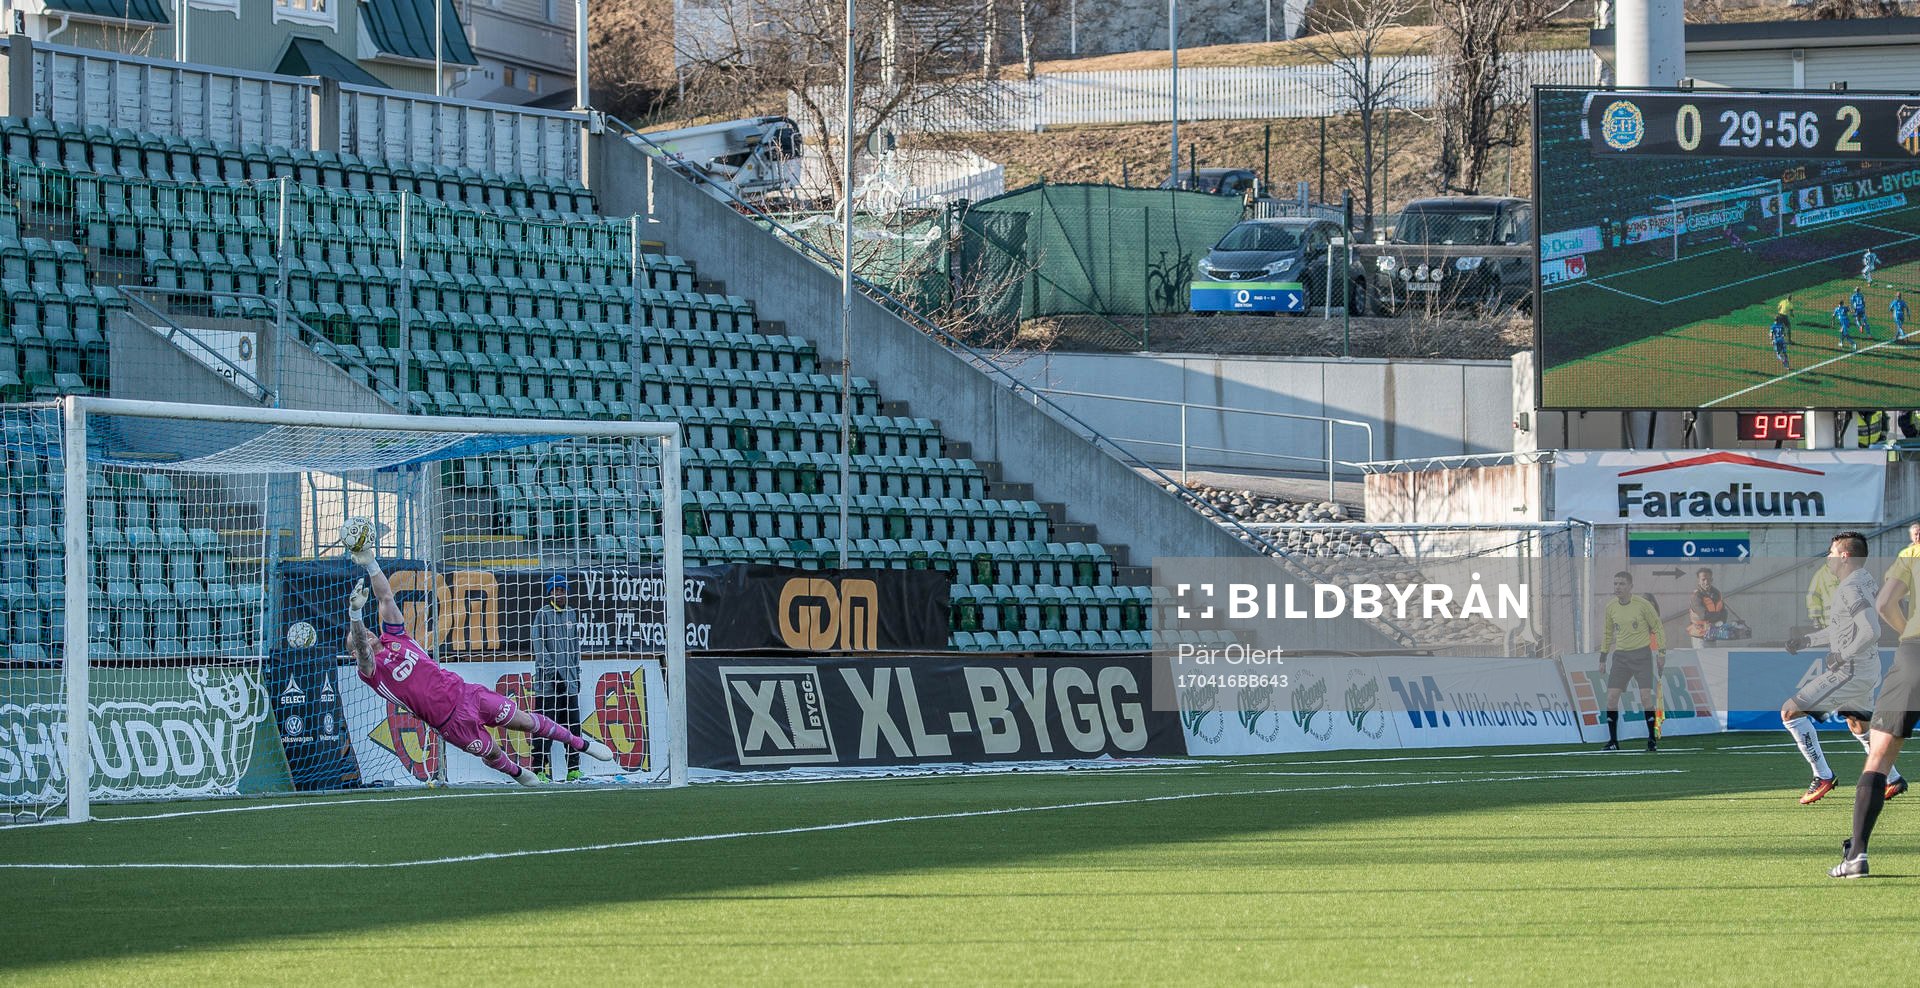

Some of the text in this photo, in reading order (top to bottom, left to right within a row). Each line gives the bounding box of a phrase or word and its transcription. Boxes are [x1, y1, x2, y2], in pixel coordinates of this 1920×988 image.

[1676, 104, 1702, 151] 0
[1719, 110, 1820, 148] 29:56
[1835, 105, 1861, 152] 2
[1617, 483, 1826, 518] Faradium
[580, 570, 706, 603] Vi förenar
[577, 612, 711, 650] din IT-vaag
[280, 695, 306, 704] SELECT
[801, 680, 822, 727] BYGG
[838, 666, 1148, 760] XL-BYGG
[1449, 692, 1538, 727] Wiklunds
[1537, 692, 1573, 727] Rör
[280, 735, 314, 744] olkswagen
